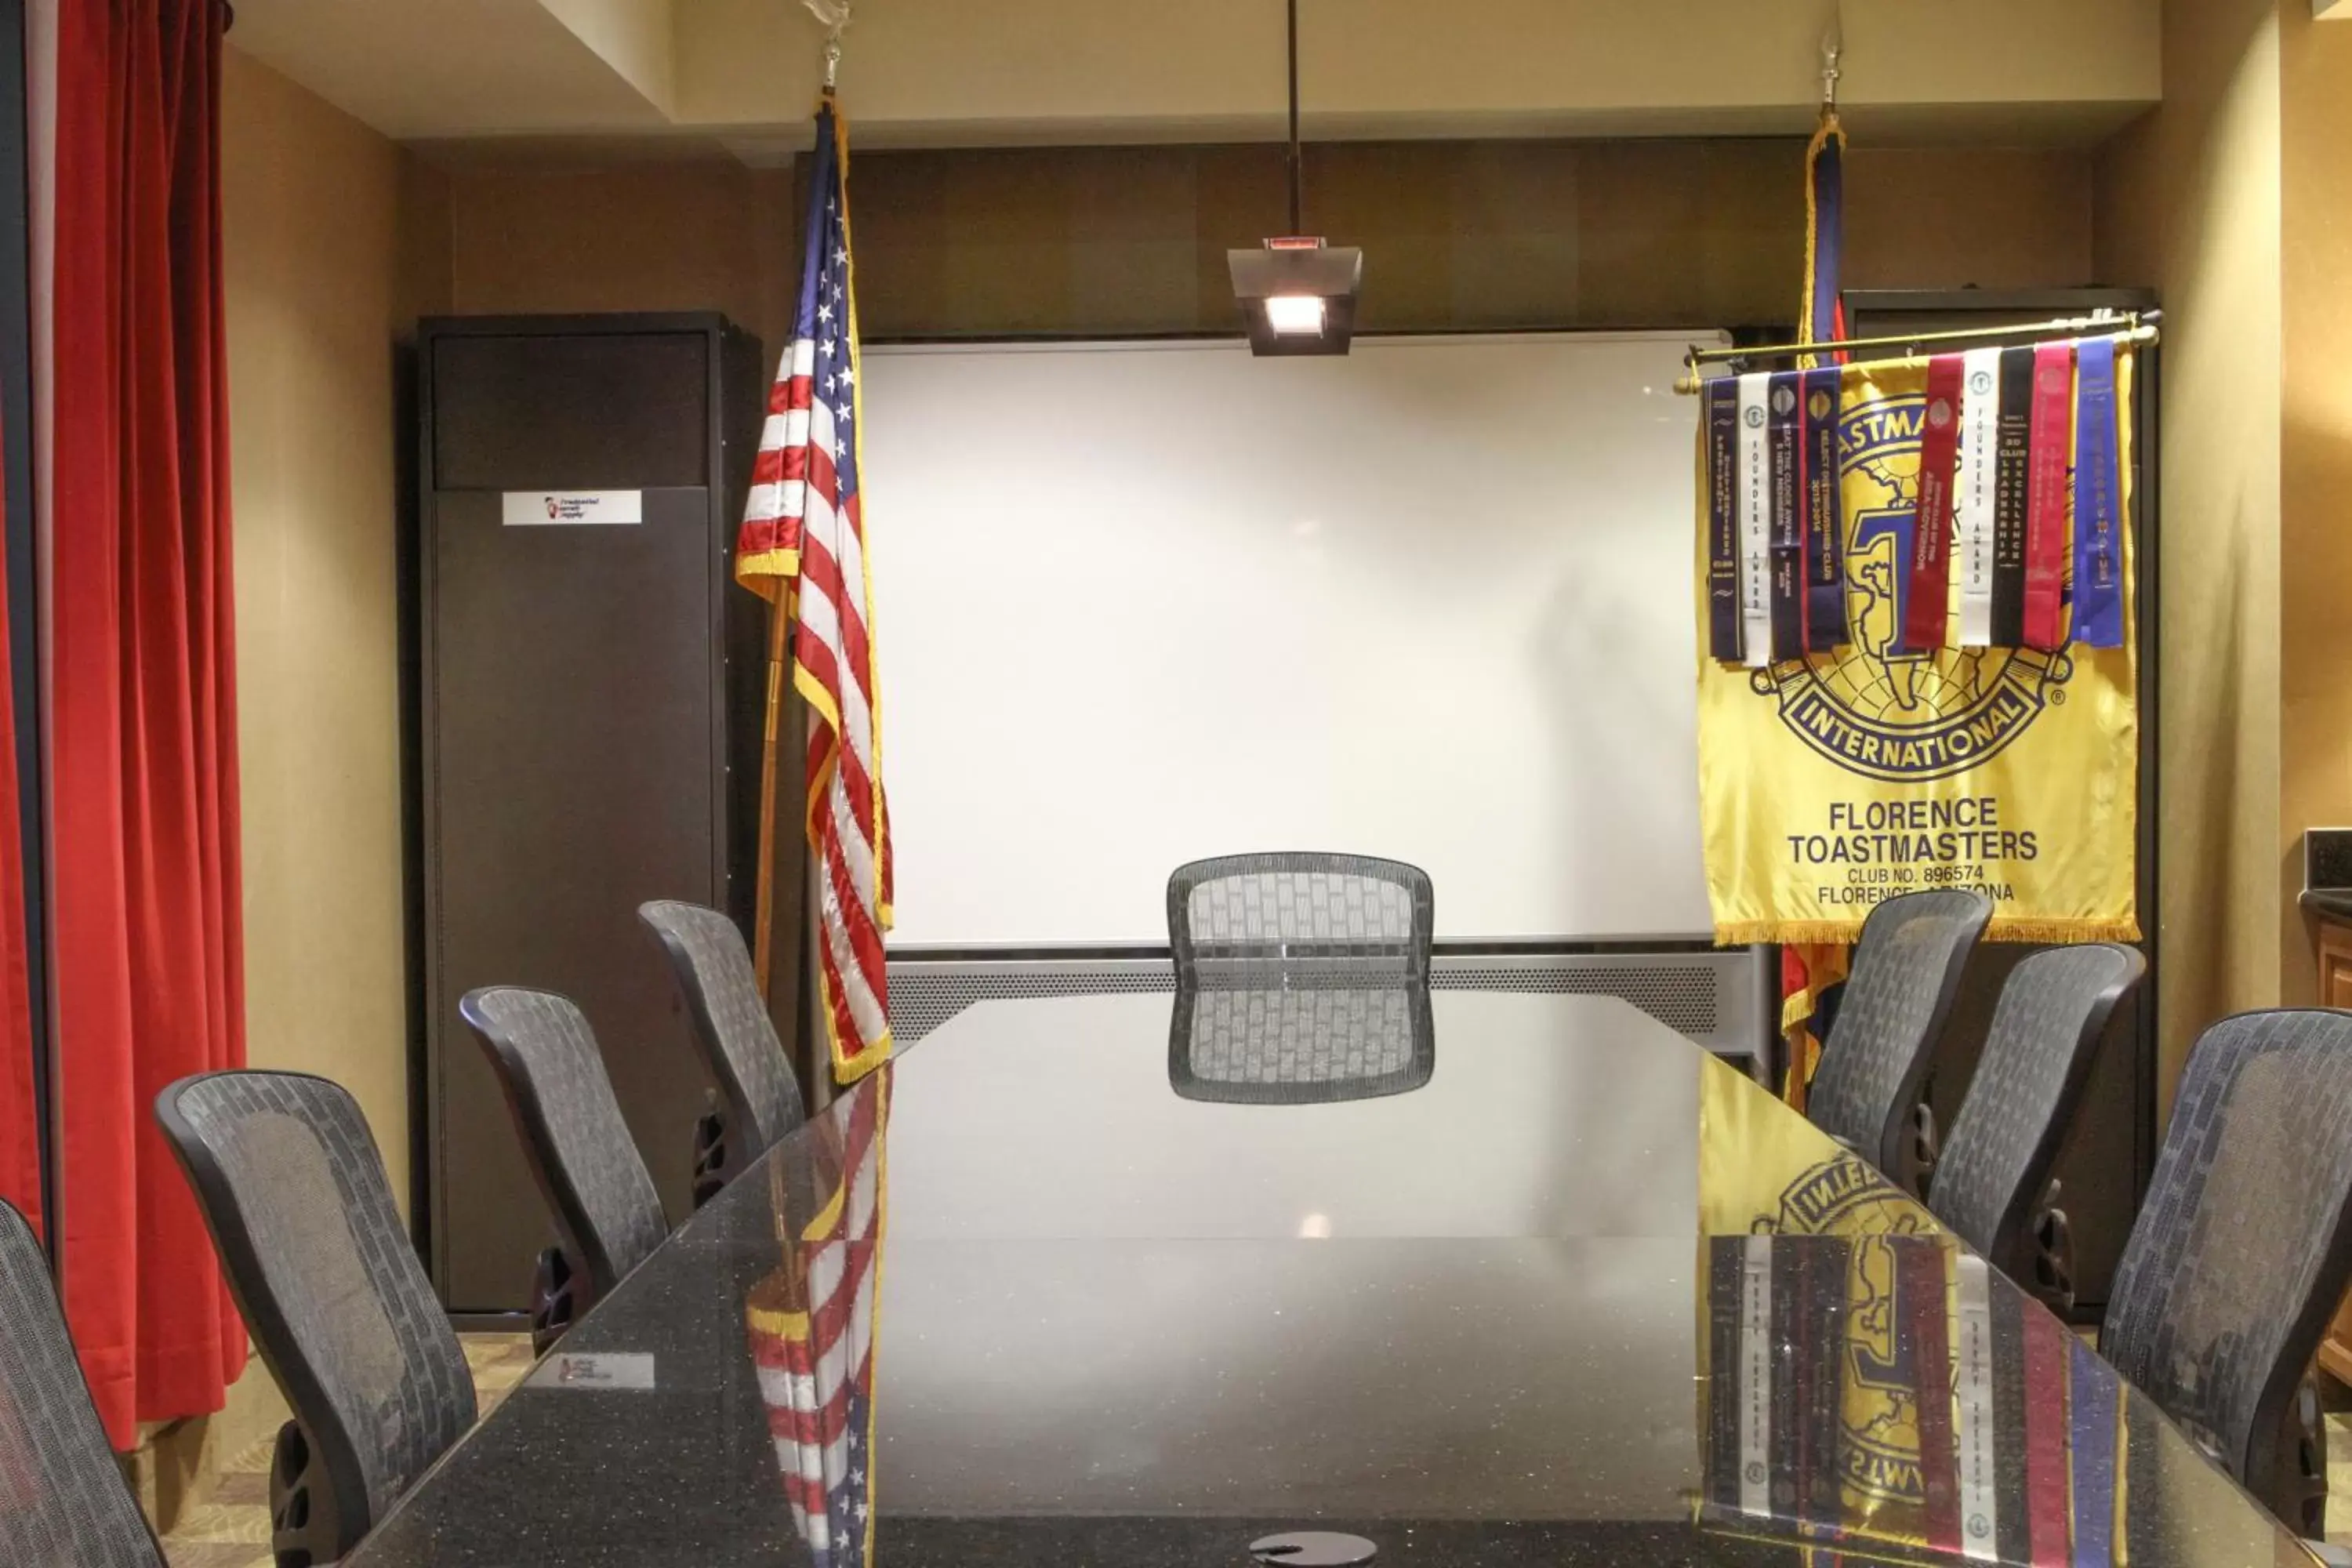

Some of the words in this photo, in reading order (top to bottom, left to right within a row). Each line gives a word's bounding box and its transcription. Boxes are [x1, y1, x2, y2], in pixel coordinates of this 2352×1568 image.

[1824, 554, 1832, 580] CLUB
[1798, 699, 2022, 768] INTERNATIONAL
[1829, 797, 1998, 830] FLORENCE
[1788, 831, 2038, 863] TOASTMASTERS
[1848, 868, 1889, 884] CLUB
[1893, 868, 1918, 883] NO.
[1924, 866, 1984, 882] 896574
